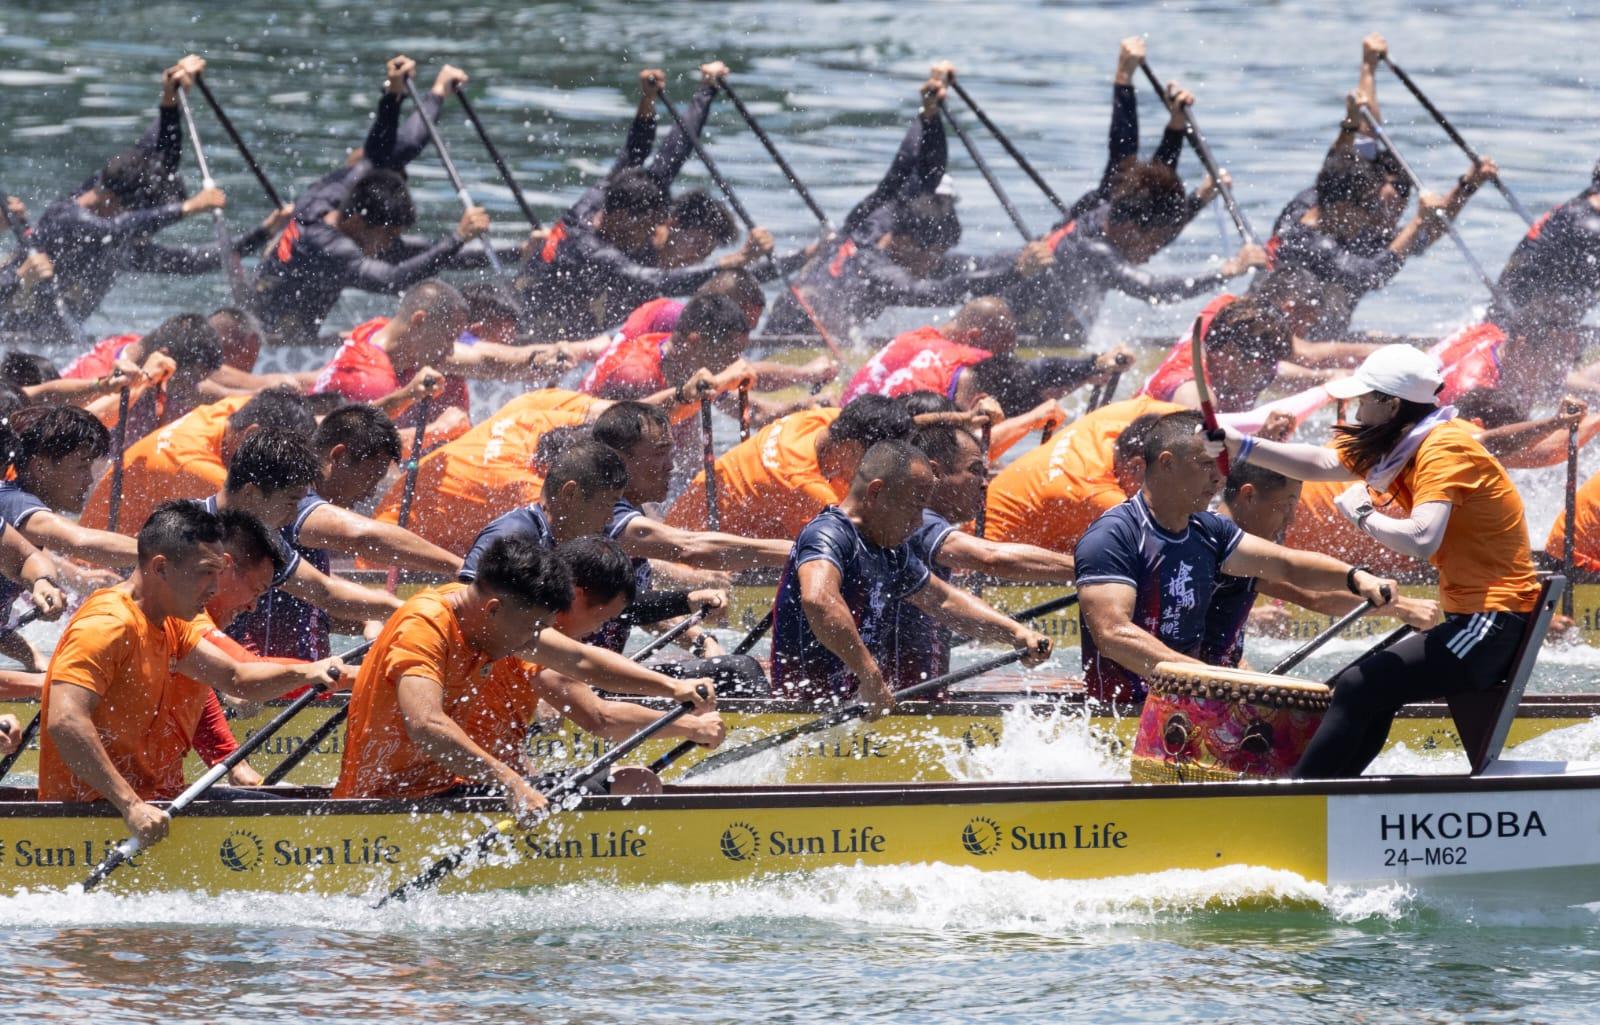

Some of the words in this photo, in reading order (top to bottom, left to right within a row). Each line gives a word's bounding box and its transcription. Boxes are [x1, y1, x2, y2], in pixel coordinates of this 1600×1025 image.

[1032, 617, 1078, 635] un
[1011, 825, 1067, 850] Sun
[1073, 822, 1128, 849] Life
[1381, 810, 1547, 840] HKCDBA
[15, 840, 75, 867] Sun
[273, 839, 335, 866] Sun
[342, 836, 400, 864] Life
[525, 833, 583, 859] Sun
[591, 829, 646, 858] Life
[769, 831, 825, 856] Sun
[832, 826, 886, 853] Life
[1384, 846, 1467, 867] 24-M62
